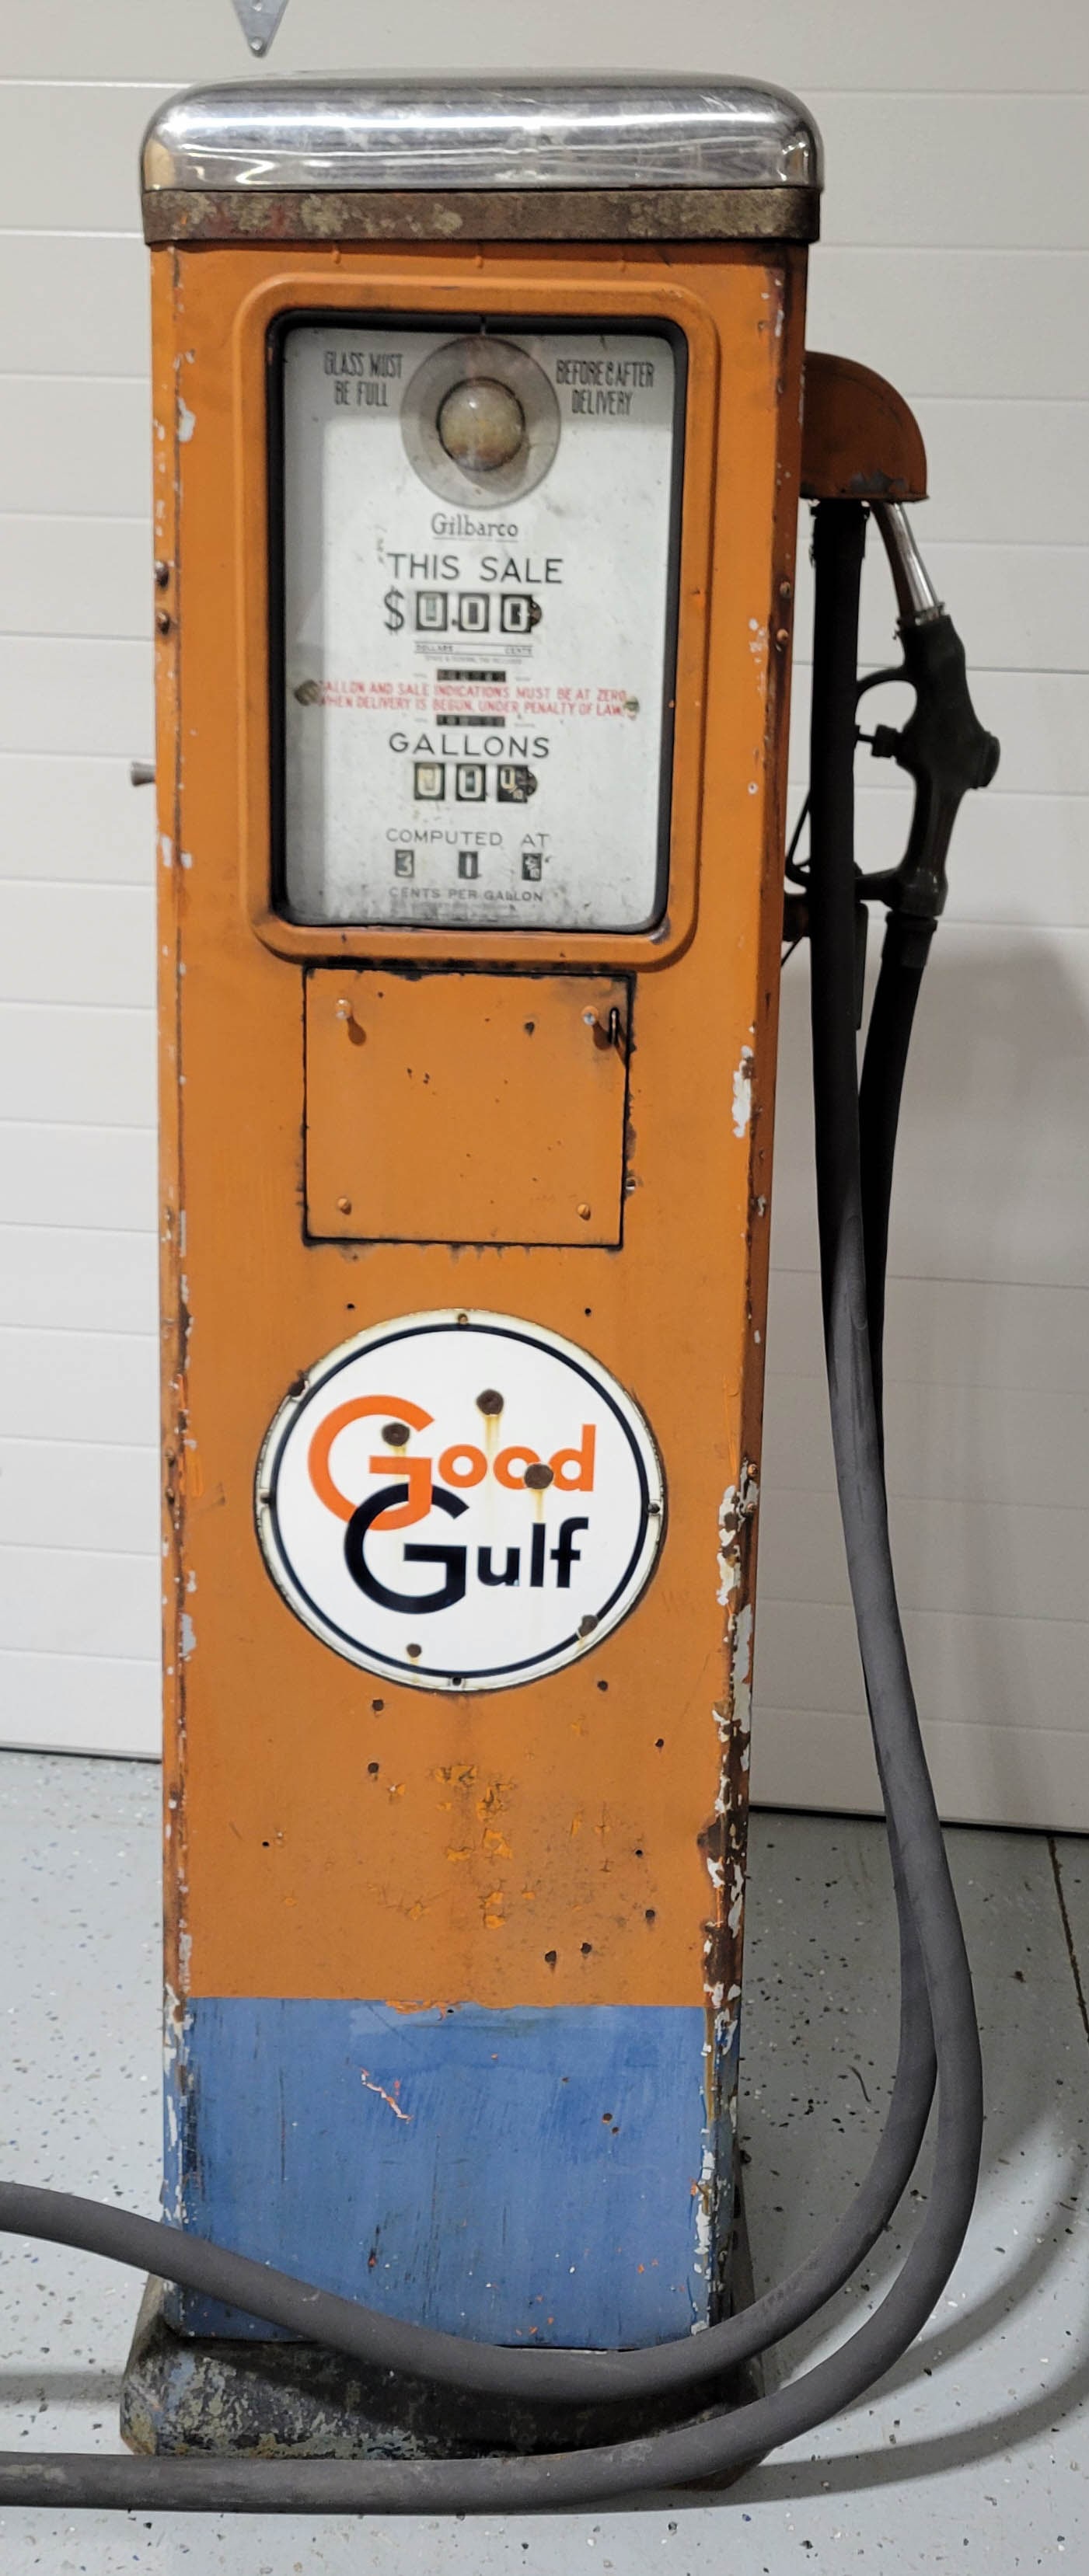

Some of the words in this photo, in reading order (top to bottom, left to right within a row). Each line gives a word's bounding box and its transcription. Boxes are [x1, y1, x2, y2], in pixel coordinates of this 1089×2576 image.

[324, 351, 364, 377] GLASS
[369, 353, 403, 379] MUST
[335, 380, 350, 406] BE
[358, 381, 389, 407] FULL
[572, 389, 634, 416] DELIVERY
[431, 512, 518, 538] Gilbarco
[387, 552, 460, 580] THIS
[480, 556, 563, 584] SALE
[371, 681, 393, 694] AND
[398, 682, 428, 695] SALE
[435, 684, 508, 699] INDICATIONS
[516, 688, 550, 699] MUST
[357, 697, 410, 710] DELIVERY
[524, 702, 576, 715] PENALTY
[389, 732, 550, 758] GALLONS
[386, 828, 503, 846] COMPUTED
[522, 833, 550, 848] AT
[389, 887, 441, 899] CENTS
[448, 889, 479, 900] PER
[483, 891, 543, 902] GALLON
[307, 1394, 597, 1532] Good
[344, 1482, 589, 1615] Gulf
